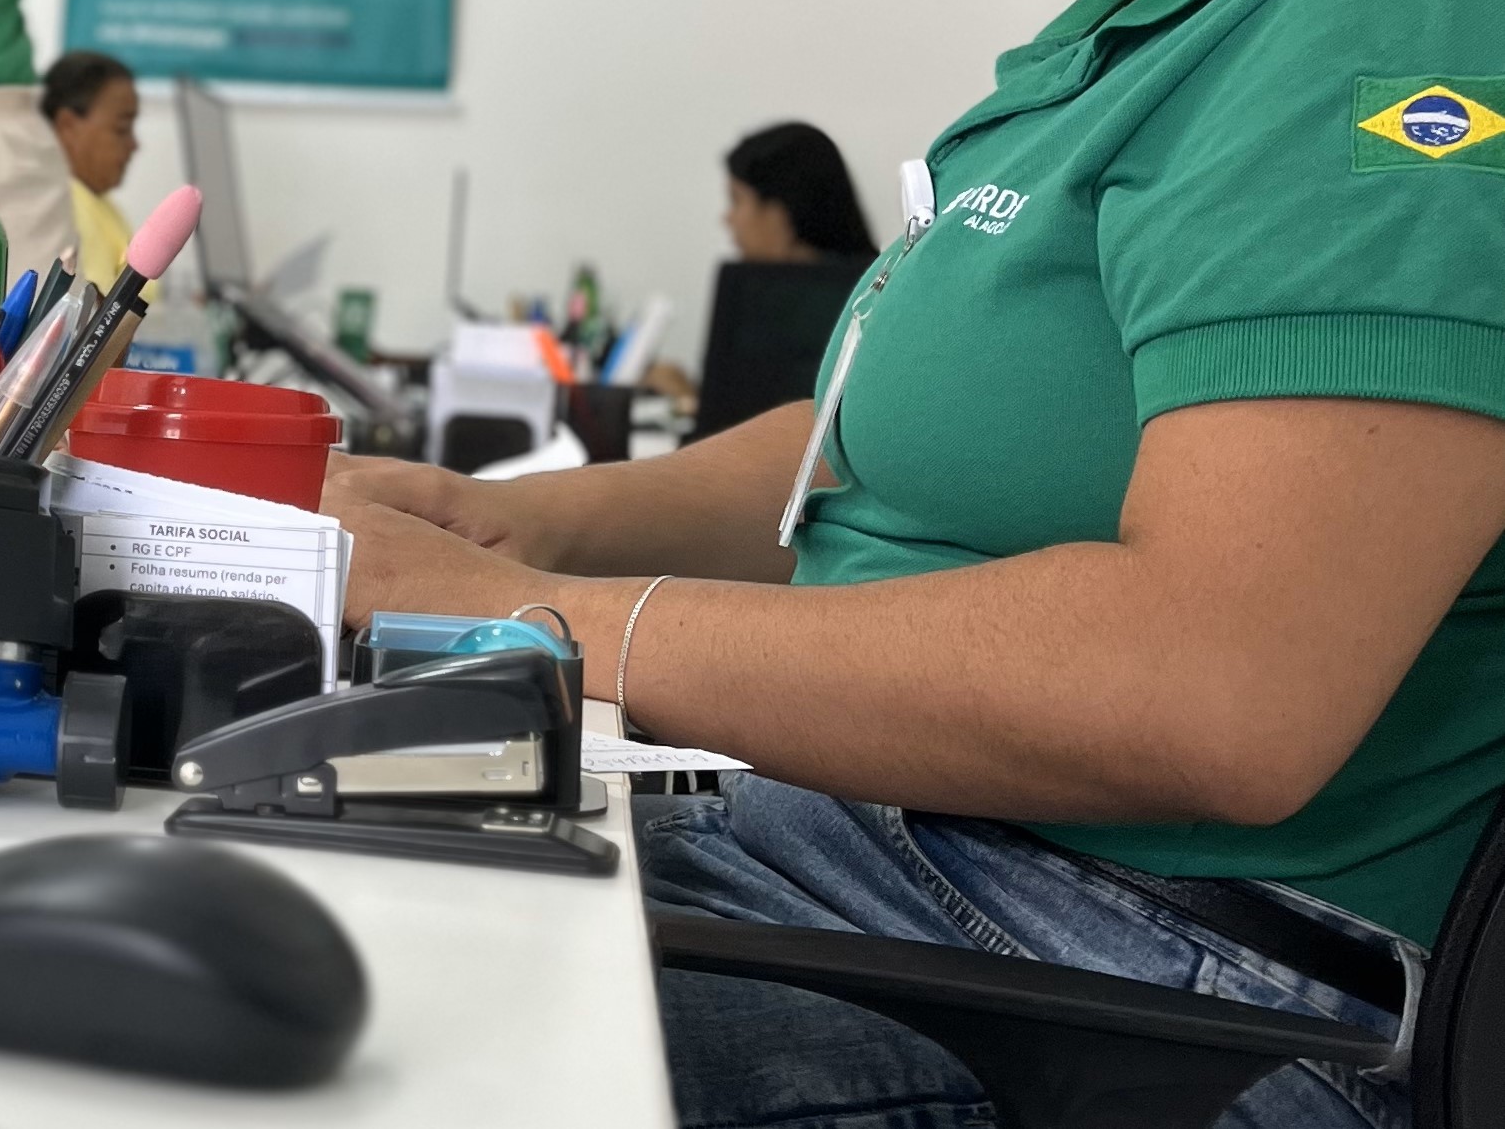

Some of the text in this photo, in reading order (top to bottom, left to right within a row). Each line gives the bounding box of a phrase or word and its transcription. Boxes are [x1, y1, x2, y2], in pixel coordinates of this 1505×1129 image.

[149, 524, 250, 542] TARIFA SOCIAL
[132, 542, 191, 558] RG E CPF
[131, 562, 287, 586] Folha resumo (renda per
[172, 584, 193, 596] até
[196, 587, 228, 598] meio
